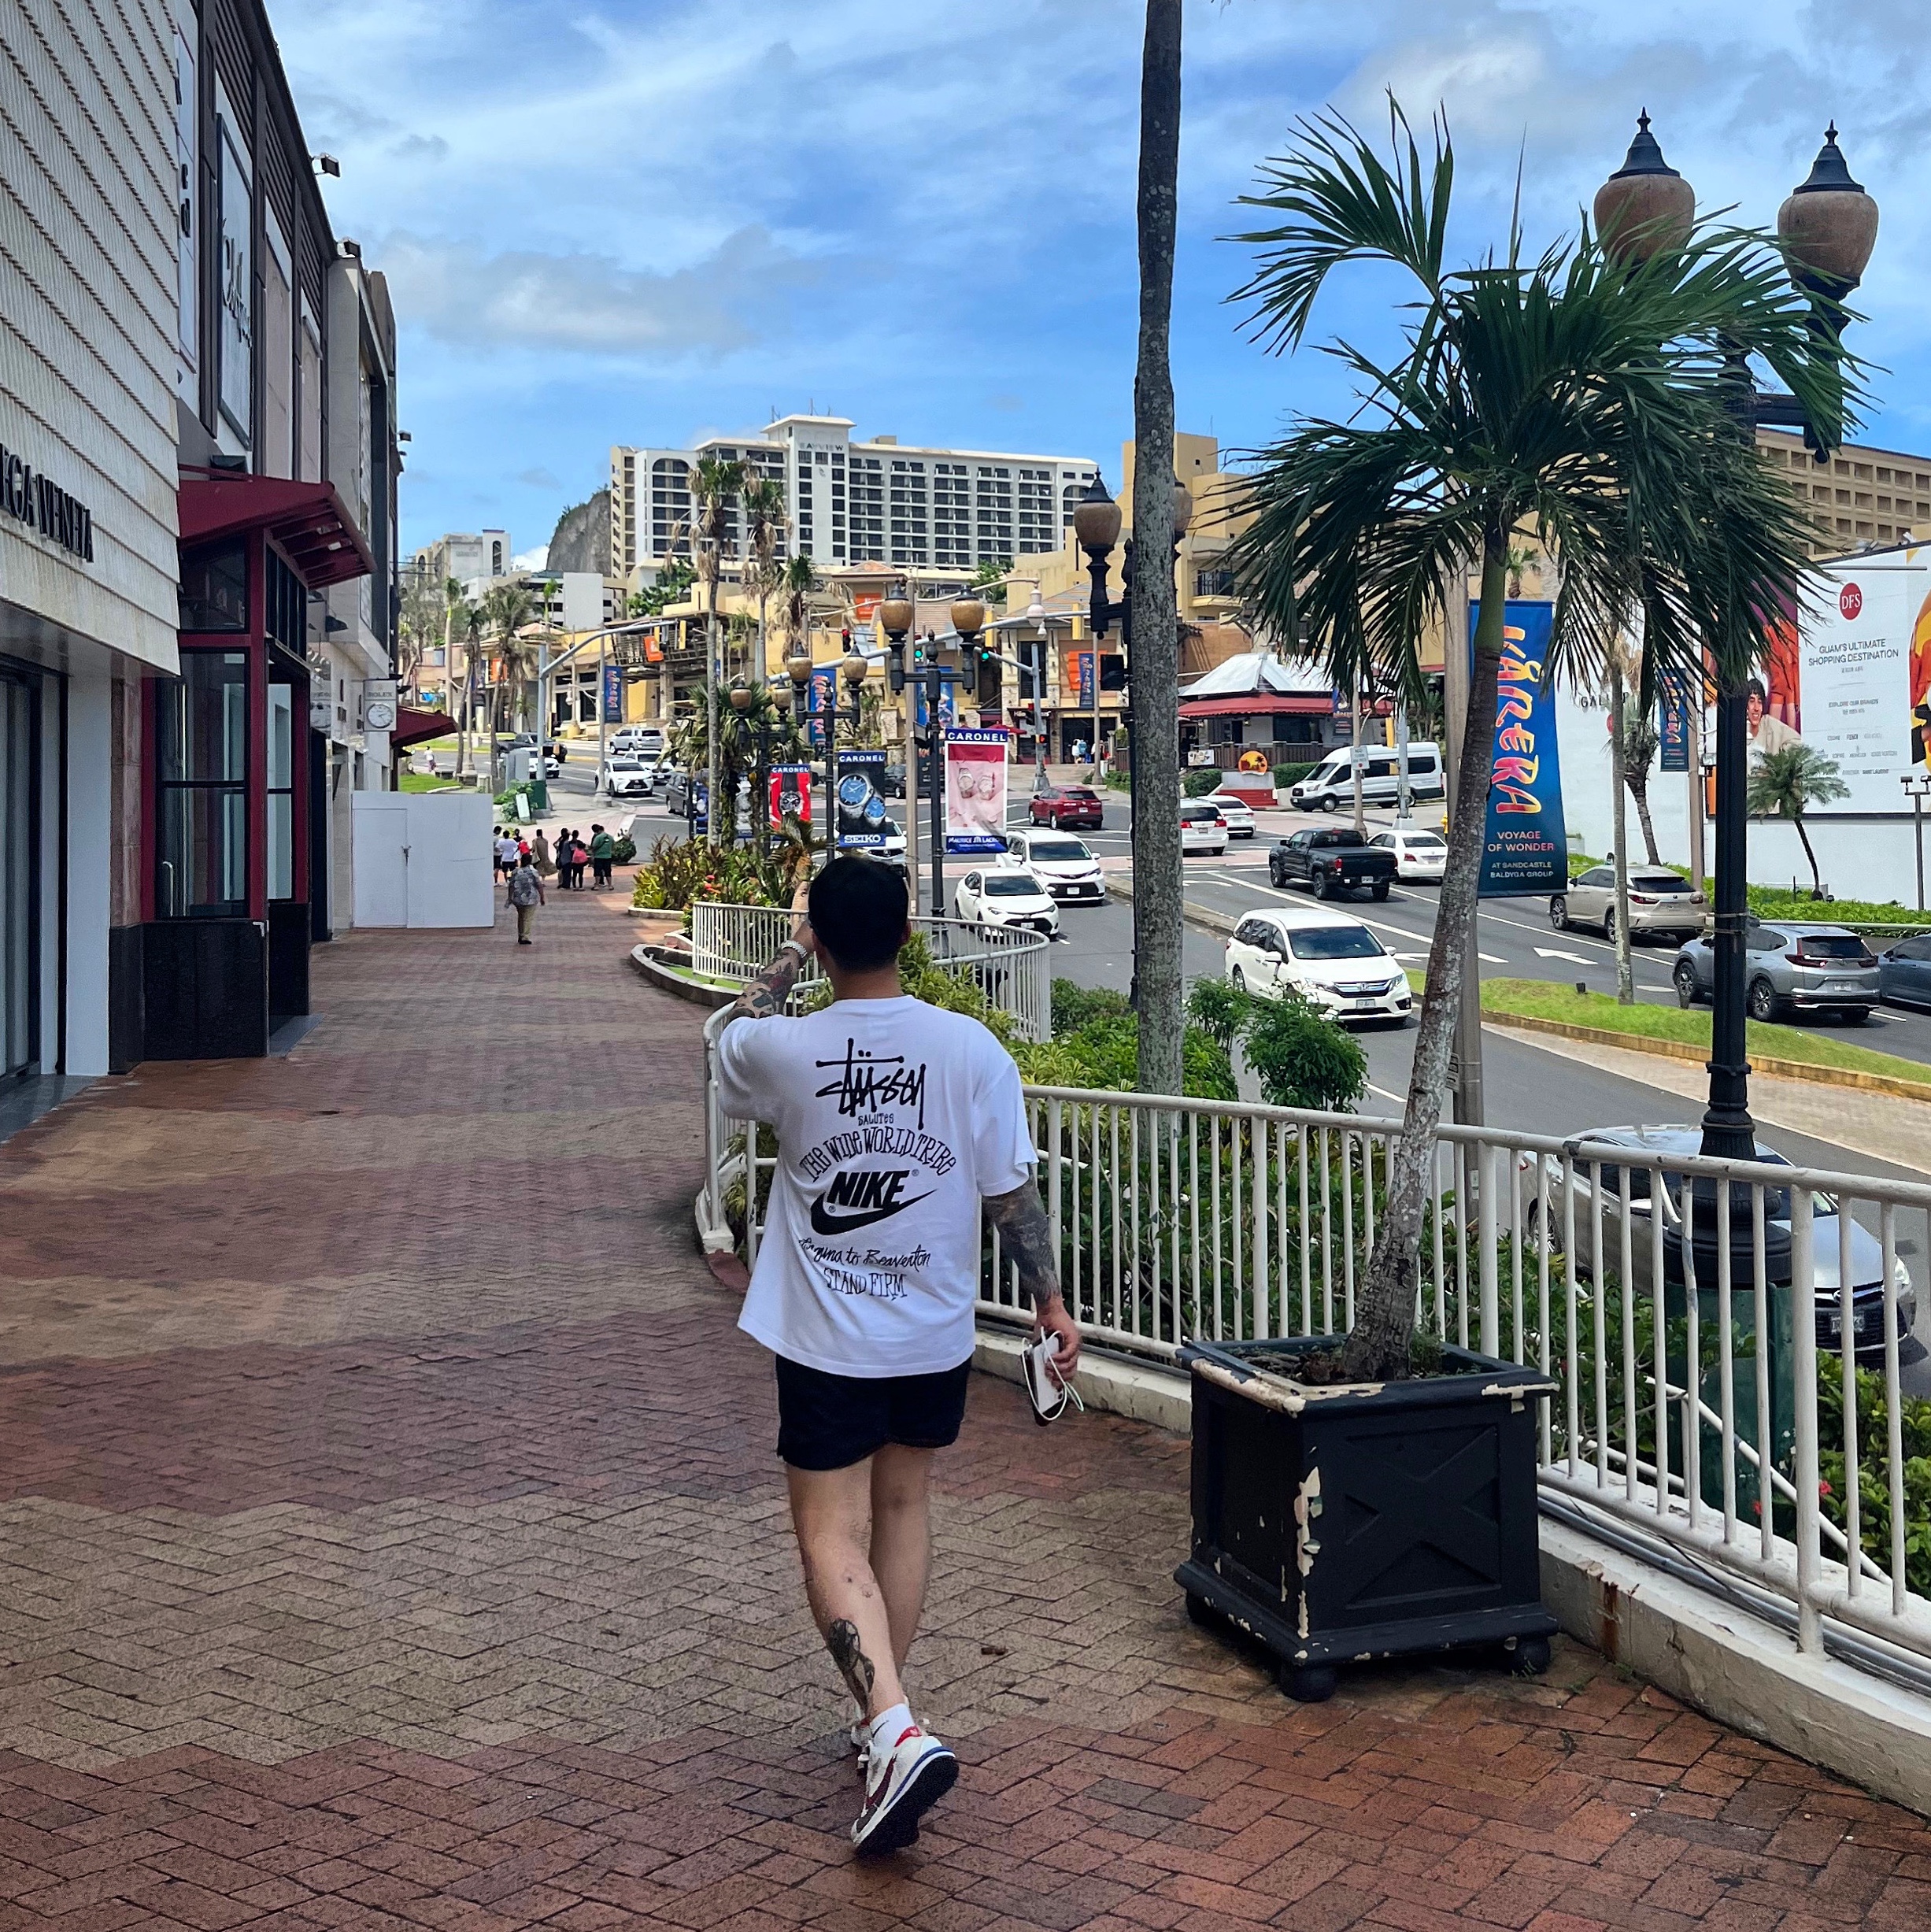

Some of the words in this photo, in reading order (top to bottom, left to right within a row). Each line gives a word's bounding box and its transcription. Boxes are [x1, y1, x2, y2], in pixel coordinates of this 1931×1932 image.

[1842, 593, 1861, 609] DFS
[1819, 642, 1848, 654] GUAM'S
[1848, 638, 1886, 651] ULTIMATE
[1808, 654, 1847, 667] SHOPPING
[1848, 649, 1899, 663] DESTINATION
[947, 731, 1006, 742] CARONEL
[839, 754, 885, 763] CARONEL
[844, 835, 882, 844] SEIKO
[1496, 831, 1541, 840] VOYAGE
[1487, 843, 1502, 852] OF
[1505, 842, 1554, 852] WONDER
[862, 1126, 916, 1157] WORLD
[827, 1170, 911, 1209] NIKE
[845, 1246, 862, 1266] to
[863, 1244, 931, 1273] Beaverton
[823, 1268, 867, 1295] STAND
[868, 1272, 908, 1301] FIRM
